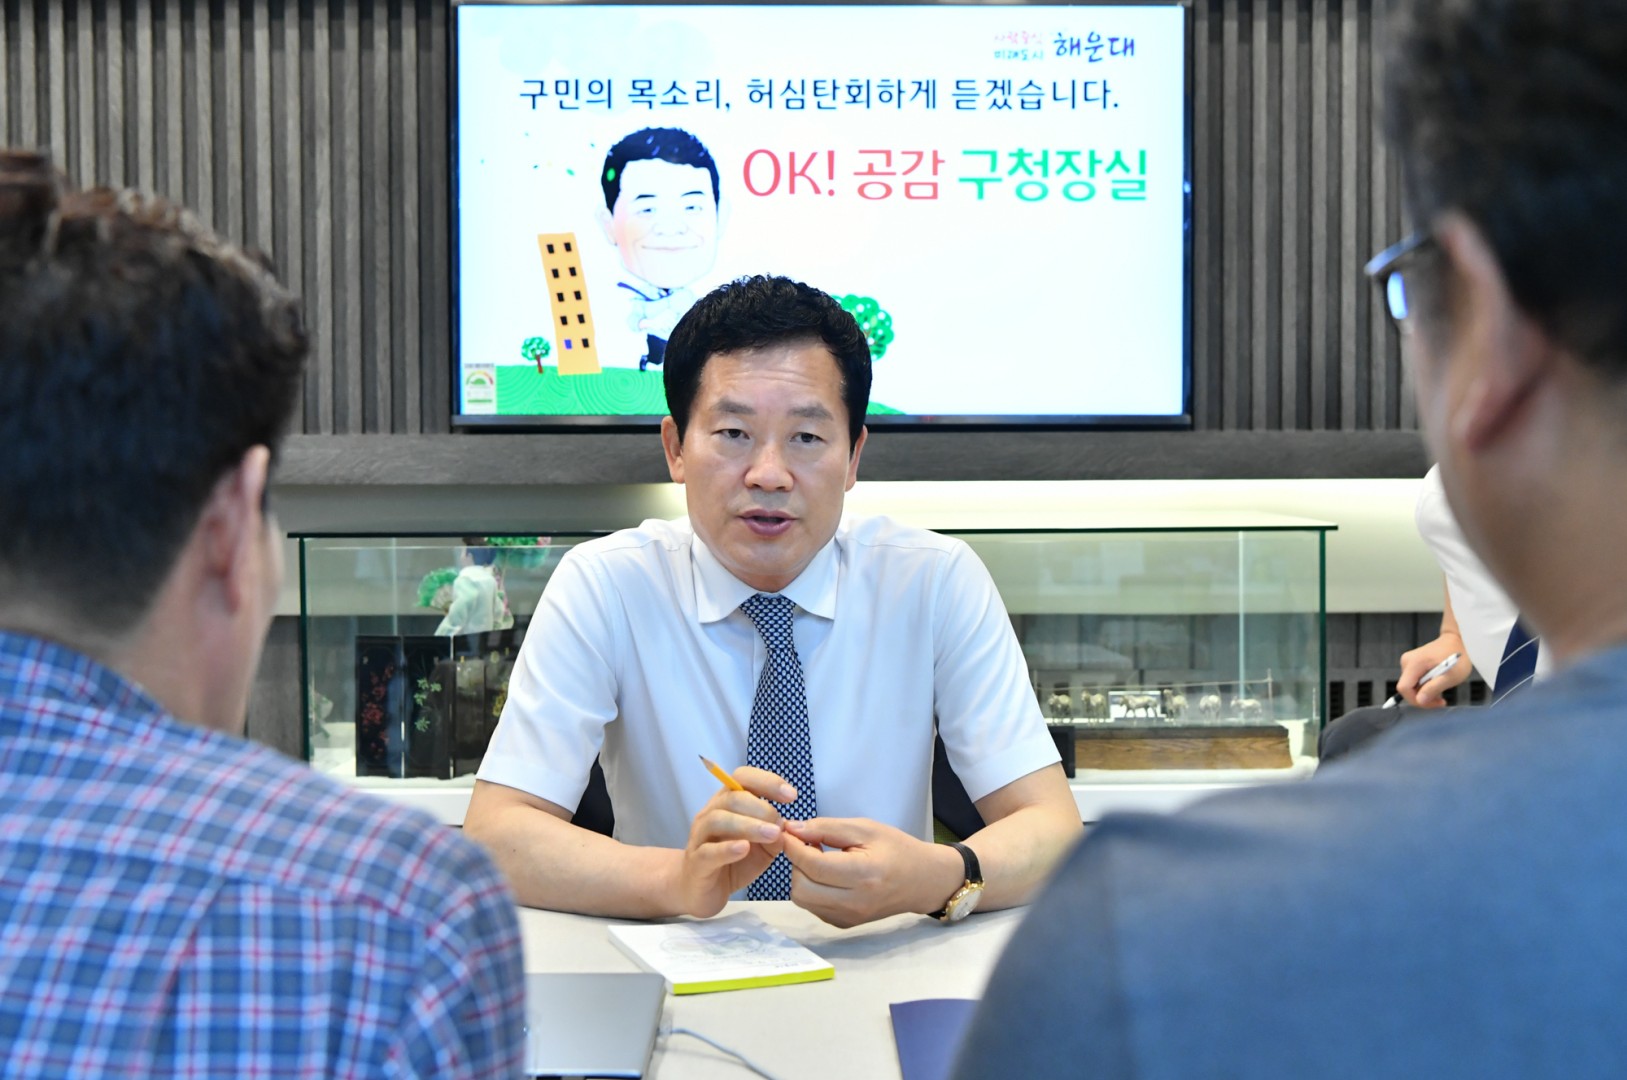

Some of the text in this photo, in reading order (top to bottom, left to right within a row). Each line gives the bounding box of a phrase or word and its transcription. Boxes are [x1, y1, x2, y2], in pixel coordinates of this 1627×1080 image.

[1053, 31, 1135, 63] 해운대
[520, 78, 1119, 112] 구민의 목소리, 허심탄회하게 듣겠습니다.
[743, 147, 1147, 202] OK! 공감 구청장실
